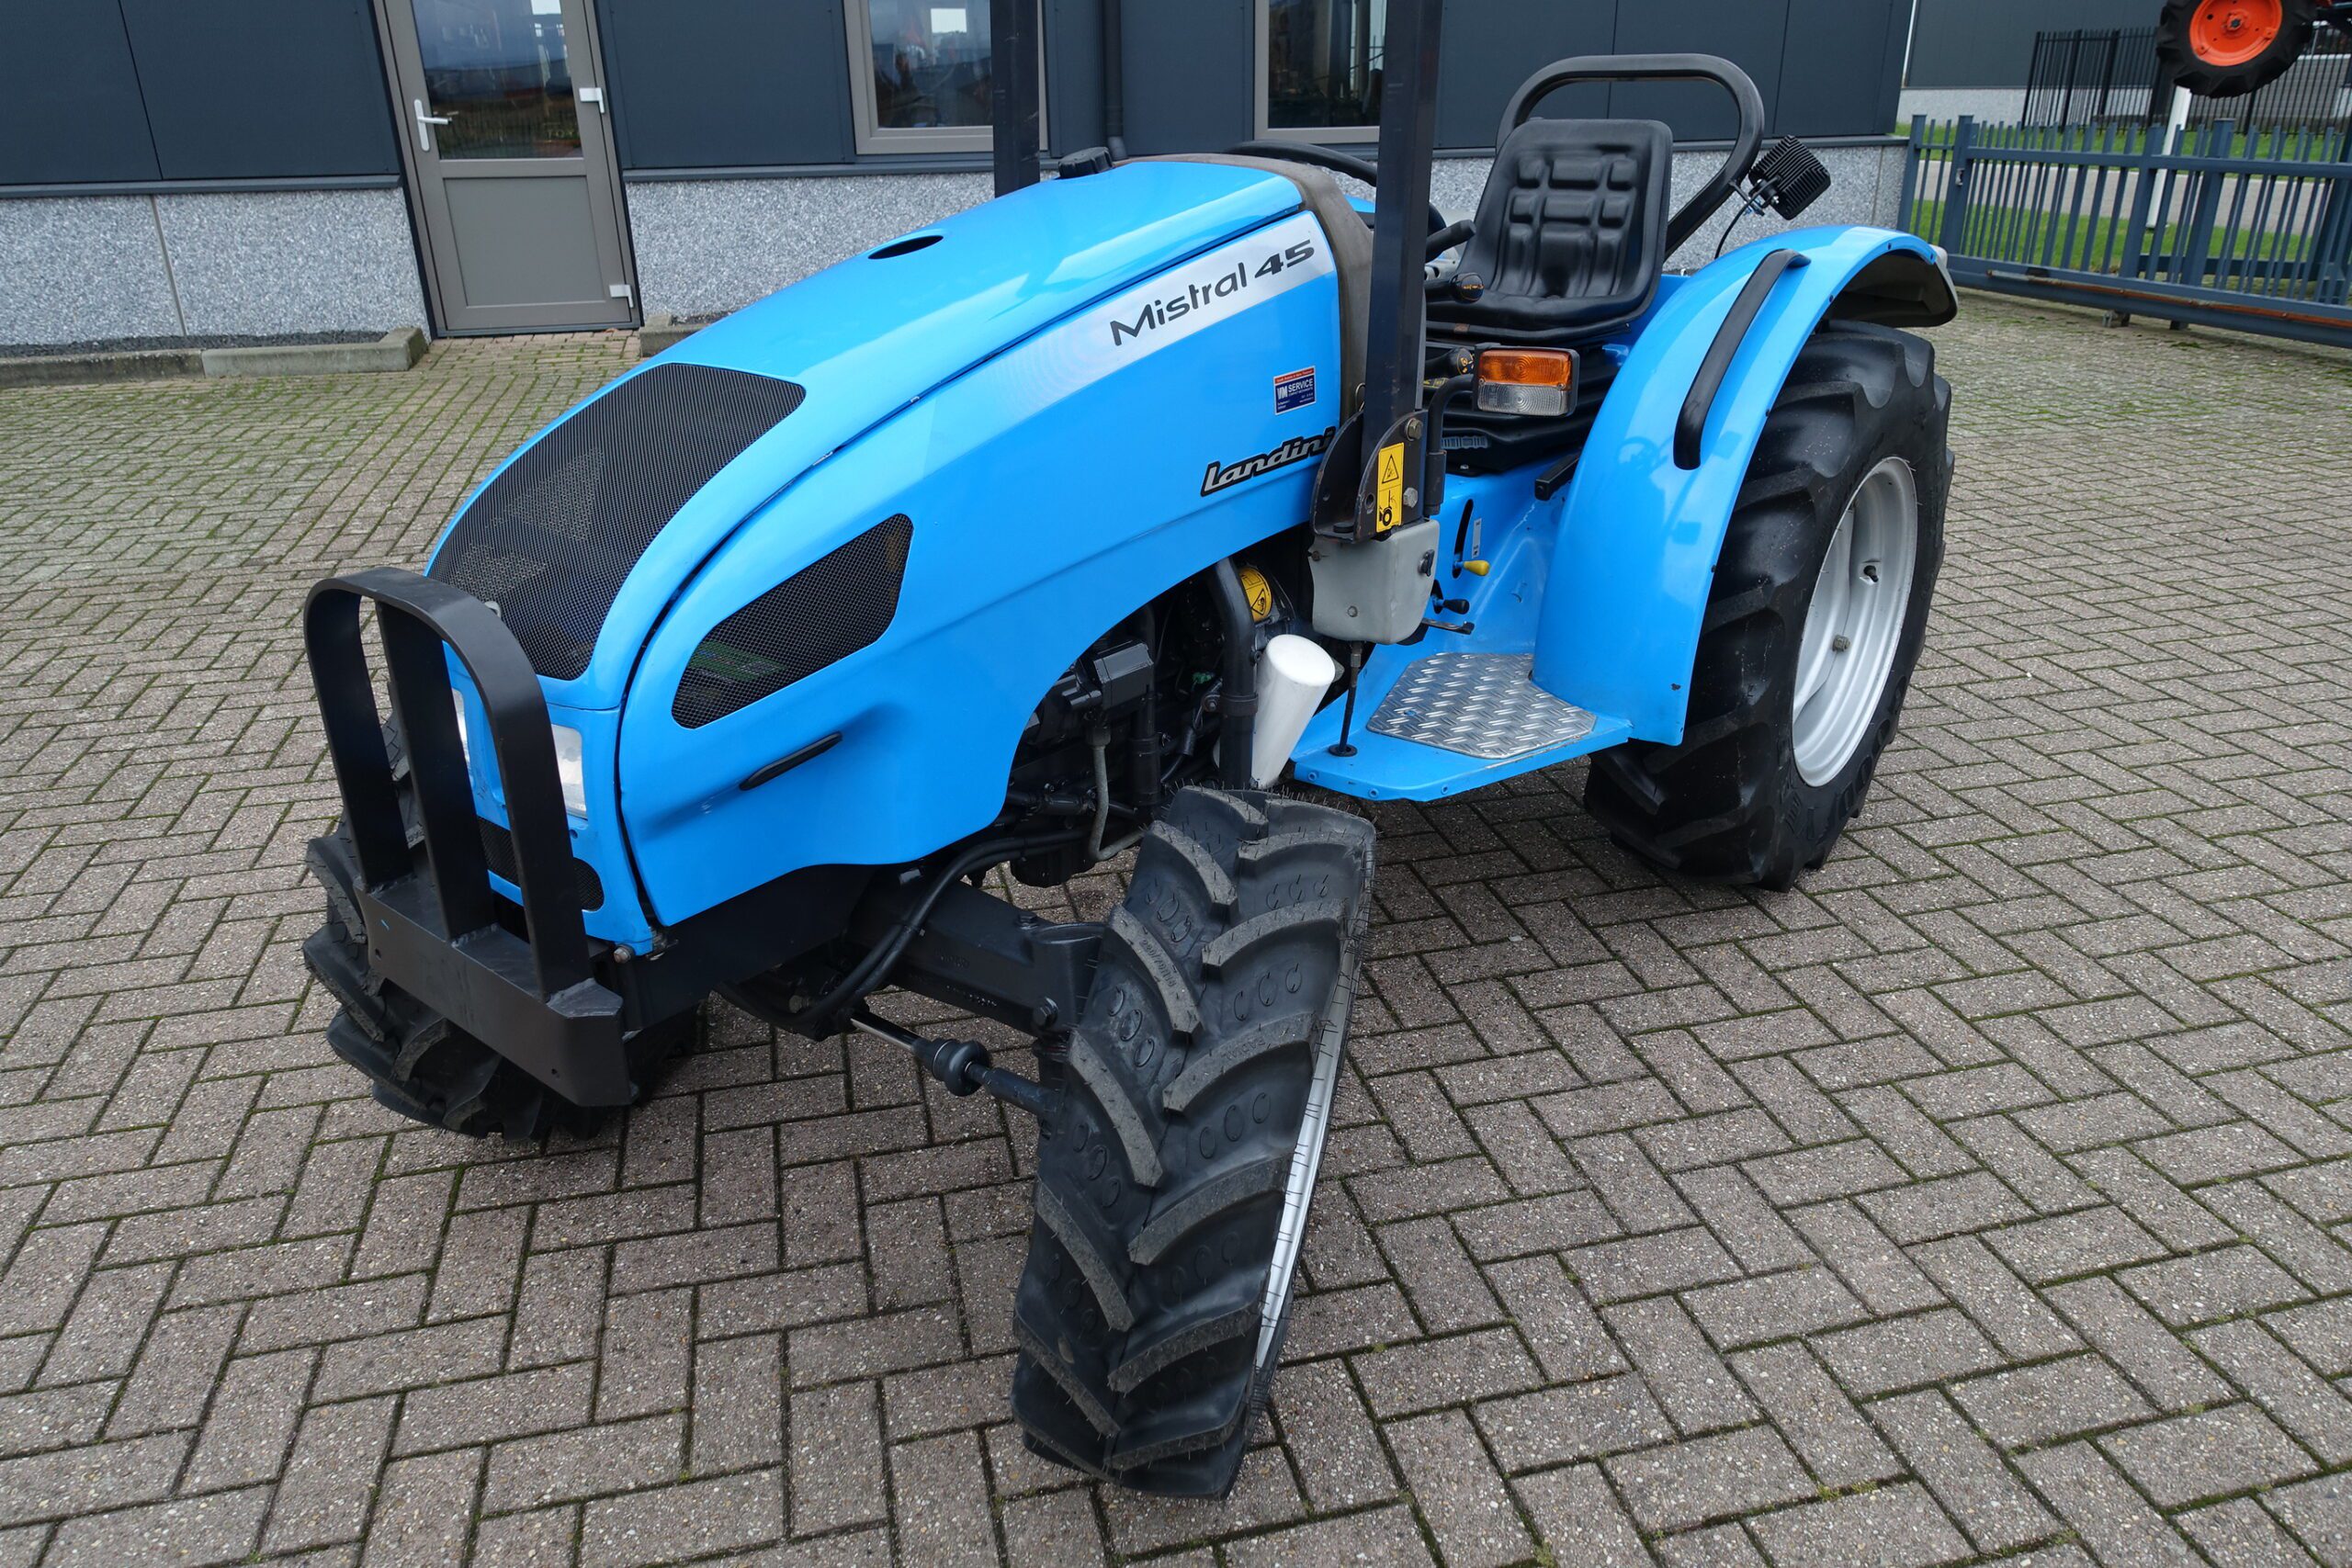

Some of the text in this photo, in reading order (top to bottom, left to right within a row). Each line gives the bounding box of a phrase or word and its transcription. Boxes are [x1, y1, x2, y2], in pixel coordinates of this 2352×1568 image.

[1110, 240, 1315, 346] Mistral 45
[1288, 378, 1314, 393] SERVICE
[1201, 427, 1336, 496] Landini
